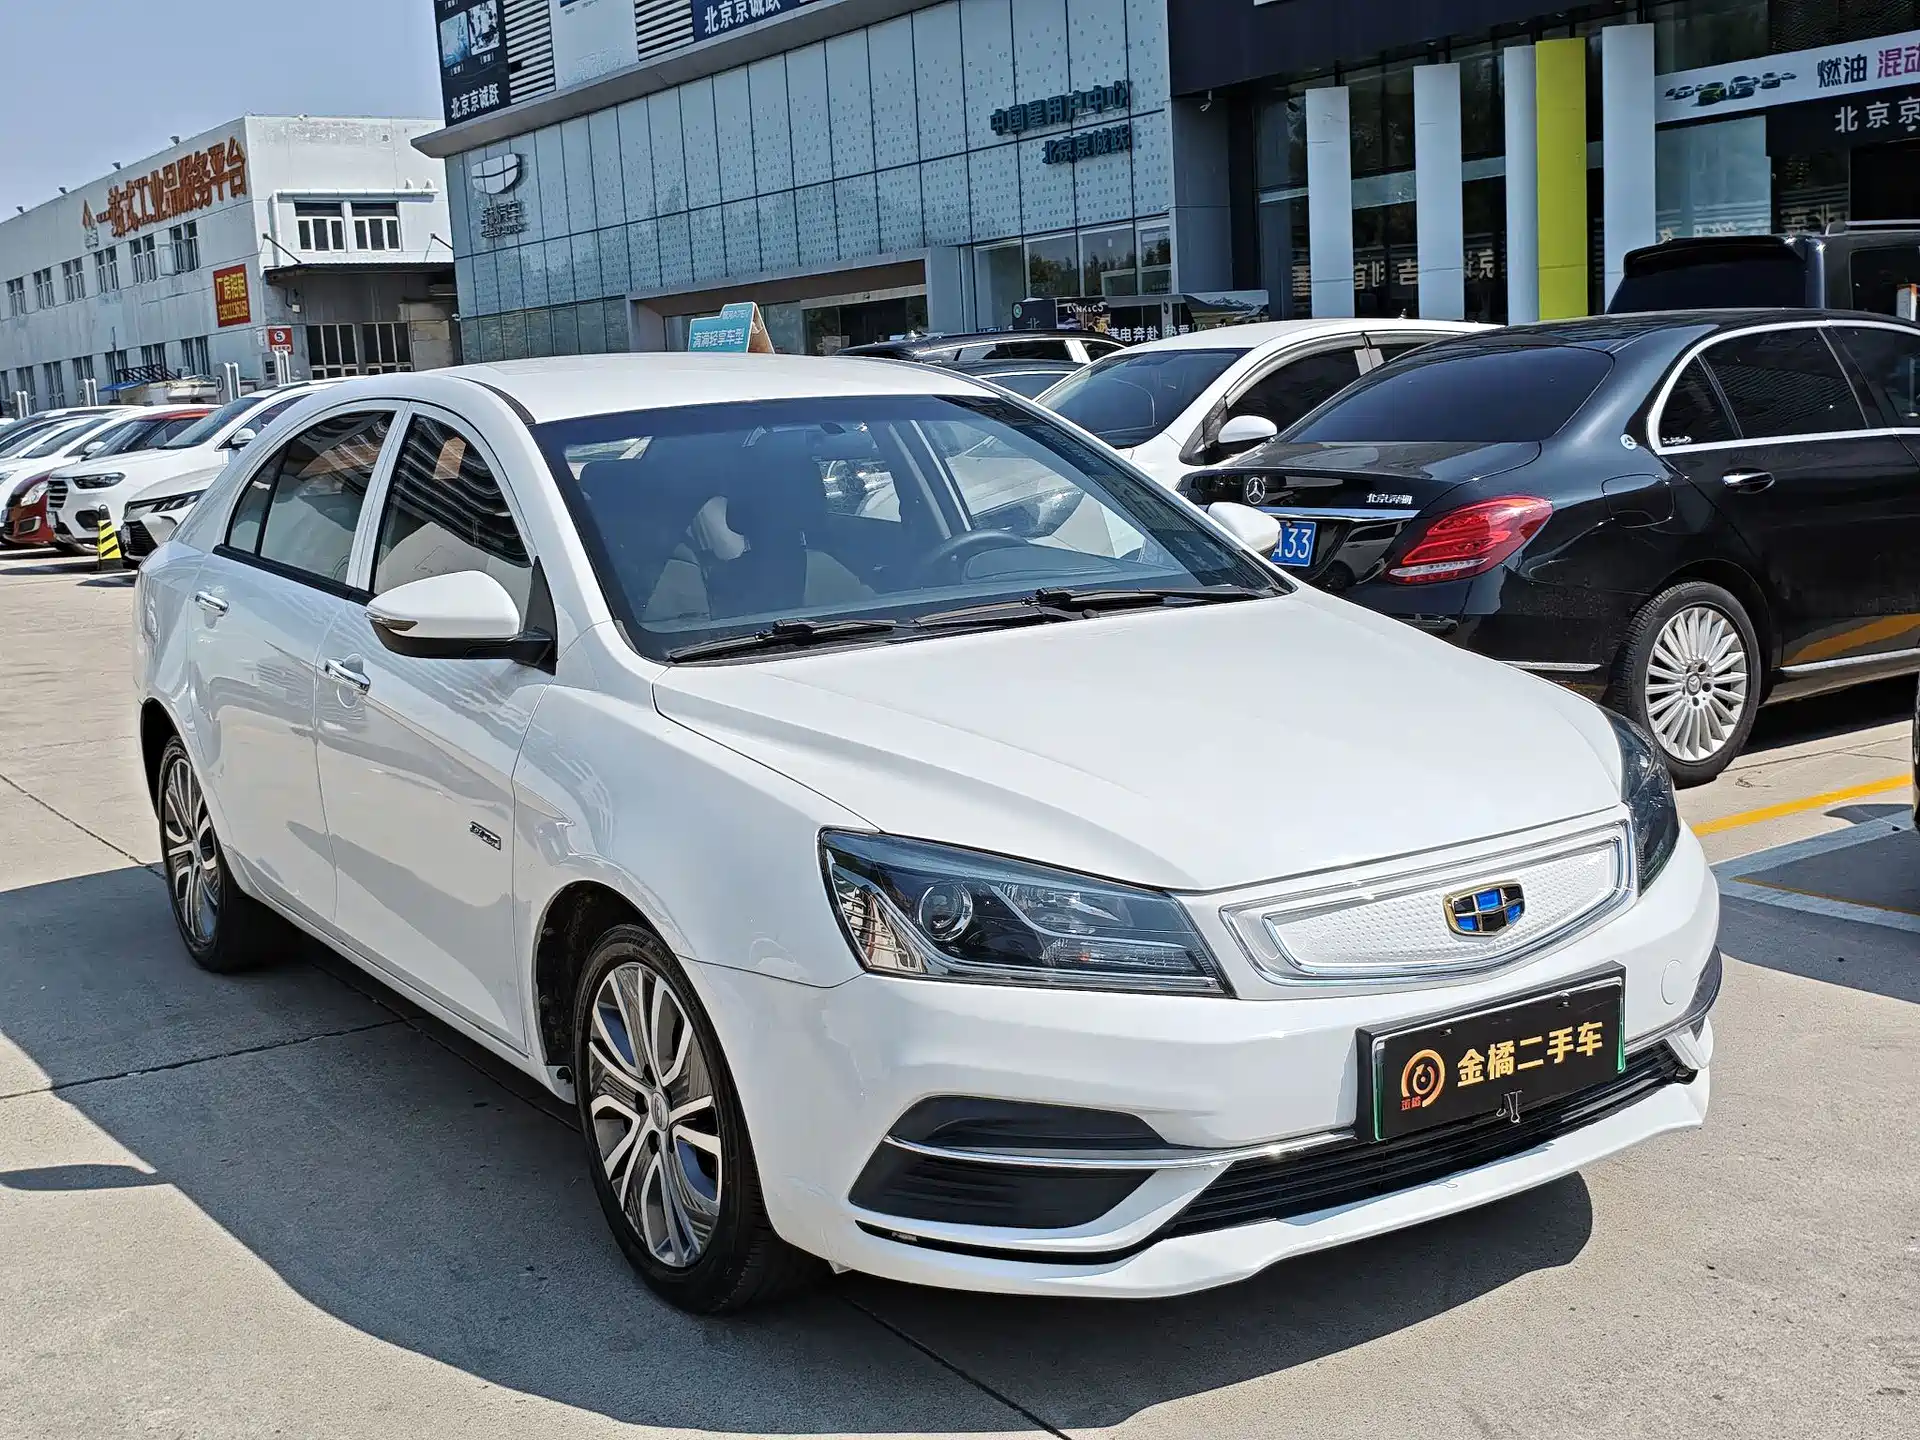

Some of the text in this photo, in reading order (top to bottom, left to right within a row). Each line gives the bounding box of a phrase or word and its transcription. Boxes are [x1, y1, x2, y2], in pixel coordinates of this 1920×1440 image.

[1817, 53, 1868, 88] 燃油
[989, 79, 1132, 137] 中国星用户中心
[1457, 1021, 1604, 1087] 金橘二手车
